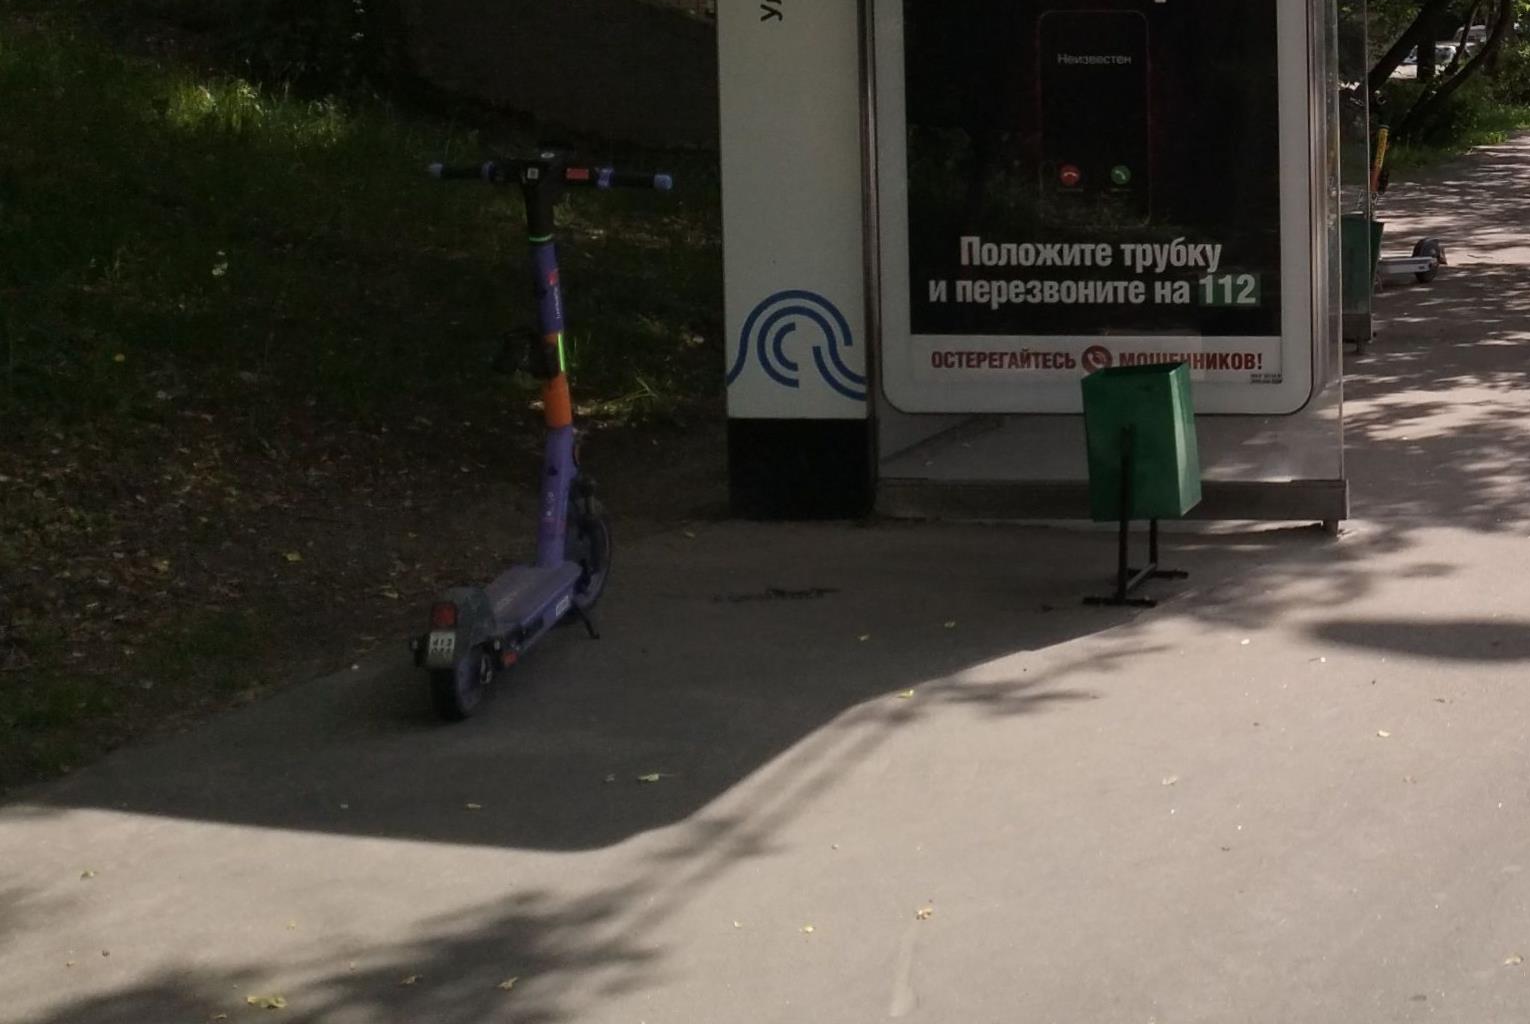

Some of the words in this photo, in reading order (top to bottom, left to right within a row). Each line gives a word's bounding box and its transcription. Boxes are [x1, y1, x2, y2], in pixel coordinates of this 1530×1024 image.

[1057, 53, 1132, 64] Неизвестен
[960, 236, 1112, 267] Положите
[1120, 237, 1222, 273] трубку
[929, 280, 947, 303] и
[956, 280, 1146, 310] перезвоните
[1154, 280, 1190, 304] на
[1199, 274, 1257, 304] 112
[931, 348, 1076, 370] ОСТЕРЕГАЙТЕСЬ
